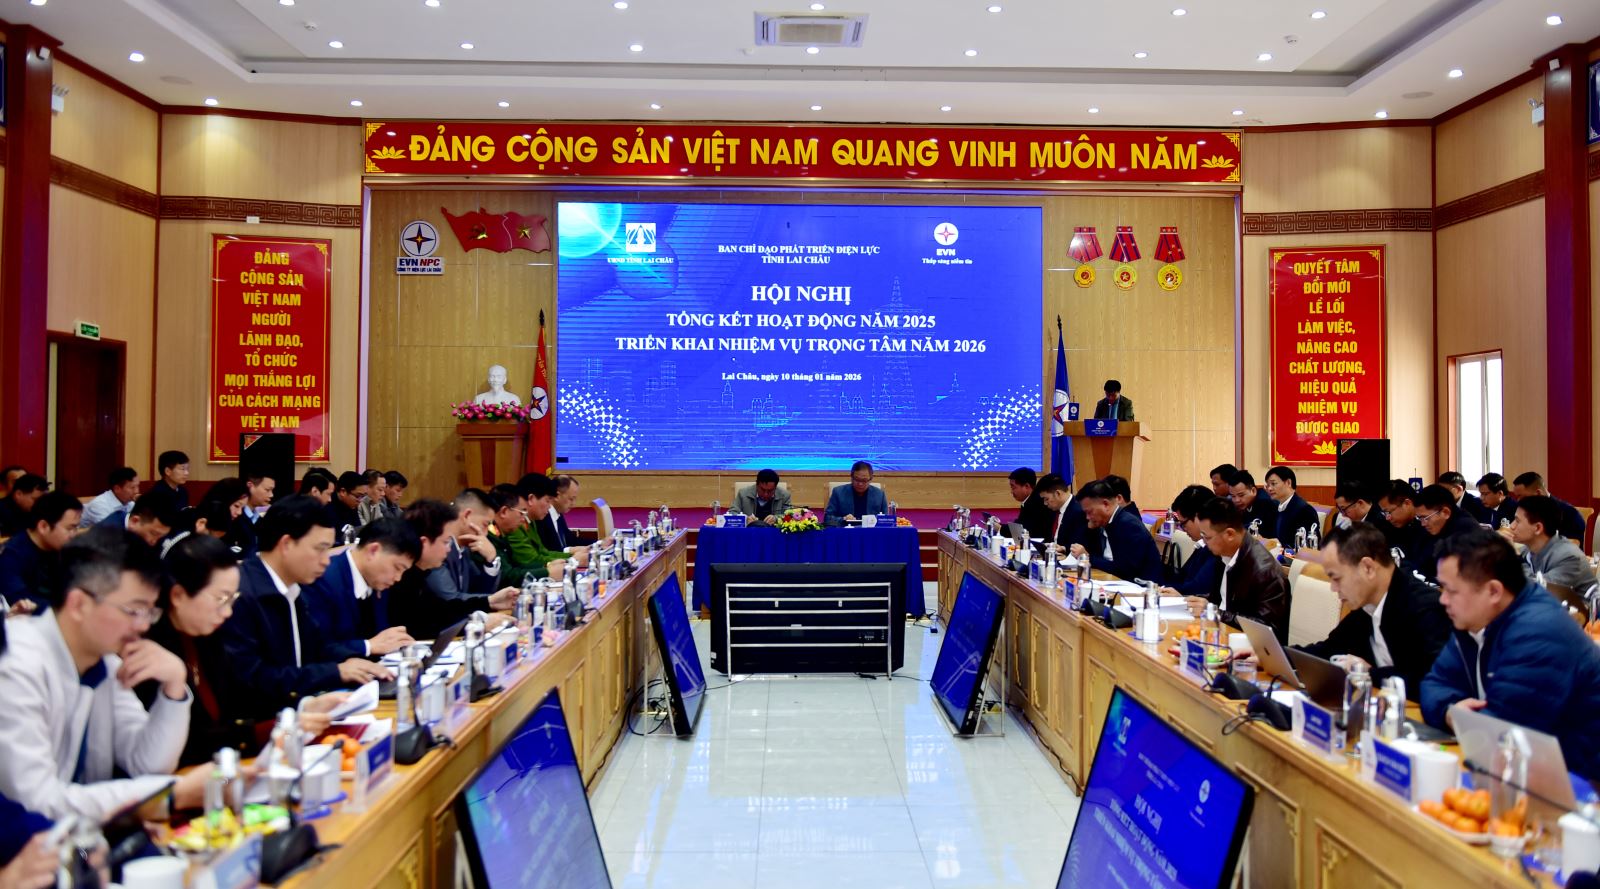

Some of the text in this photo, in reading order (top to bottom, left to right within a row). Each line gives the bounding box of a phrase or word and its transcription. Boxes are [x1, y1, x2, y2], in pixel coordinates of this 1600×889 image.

[409, 125, 1197, 171] ĐẢNG CỘNG SẢN VIỆT NAM QUANG VINH MUÔN NĂM
[255, 248, 289, 265] ĐẢNG
[762, 254, 784, 264] TỈNH
[804, 255, 830, 264] CHÂU
[780, 244, 805, 253] PHÁT
[806, 245, 834, 254] TRIỂN
[836, 246, 859, 256] ĐIỆN
[860, 246, 880, 255] LỰC
[1294, 257, 1359, 276] QUYẾT TÂM
[240, 269, 303, 287] CỘNG SẢN
[1304, 276, 1350, 294] ĐỔI MỚI
[243, 290, 301, 307] VIỆT NAM
[752, 284, 852, 305] HỘI NGHỊ
[1309, 297, 1344, 314] LỀ LỐI
[252, 309, 290, 326] NGƯỜI
[667, 311, 936, 330] TỔNG KẾT HOẠT ĐỘNG NĂM 2025
[1298, 318, 1355, 336] LÀM VIỆC,
[240, 331, 303, 349] LÃNH ĐẠO,
[616, 335, 986, 354] TRIỂN KHAI NHIỆM VỤ TRỌNG TÂM NĂM 2026
[1297, 339, 1357, 354] NÂNG CAO
[245, 348, 297, 367] TỔ CHỨC
[1289, 357, 1365, 377] CHẤT LƯỢNG,
[224, 370, 315, 391] MỌI THẮNG LỢI
[736, 373, 760, 381] Châu,
[761, 374, 779, 382] ngày
[792, 373, 813, 382] tháng
[1300, 377, 1356, 396] HIỆU QUẢ
[219, 389, 320, 410] CỦA CÁCH MẠNG
[1298, 399, 1357, 416] NHIỆM VỤ
[241, 413, 299, 431] VIỆT NAM
[1296, 421, 1359, 436] ĐƯỢC GIAO
